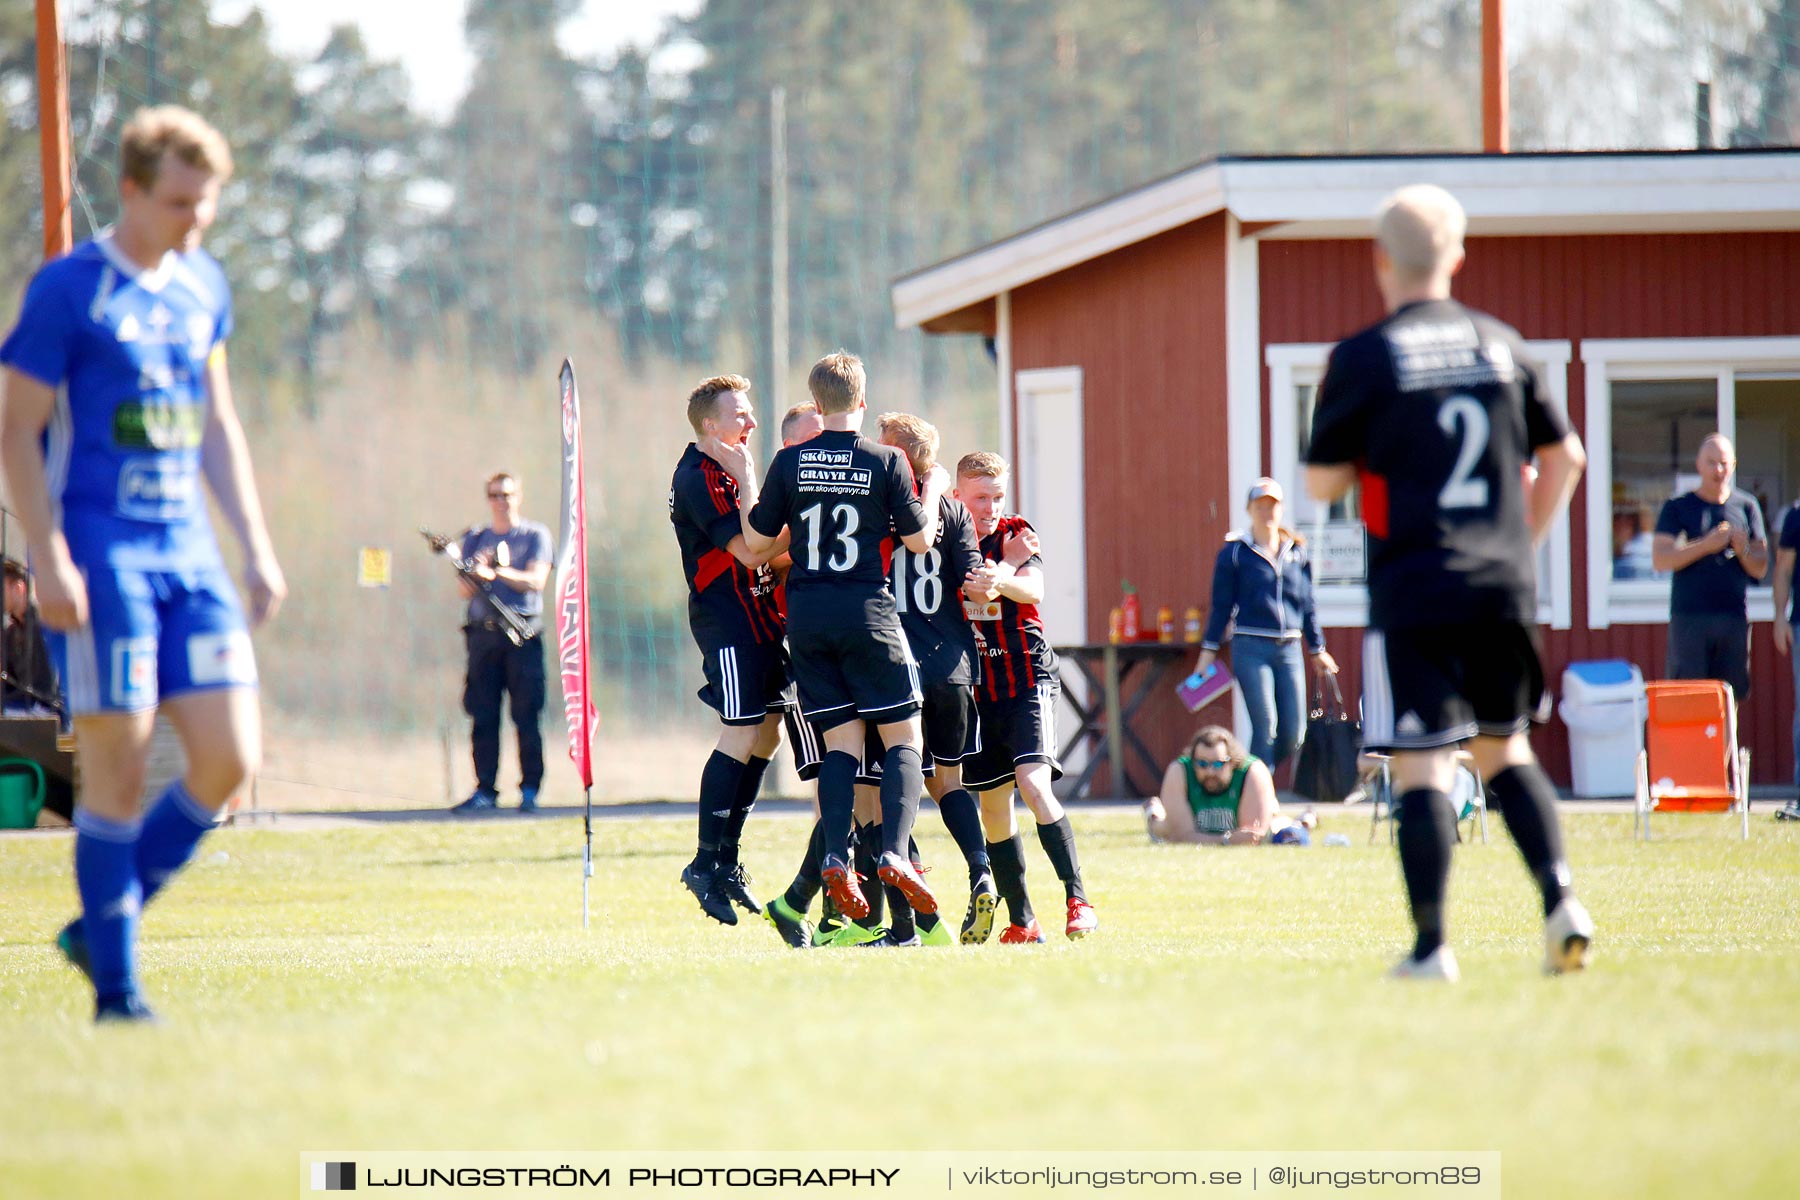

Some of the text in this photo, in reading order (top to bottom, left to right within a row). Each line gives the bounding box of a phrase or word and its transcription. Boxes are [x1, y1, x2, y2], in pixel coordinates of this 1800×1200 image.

[800, 451, 849, 463] SKÖVDE
[1437, 395, 1490, 509] 2
[798, 485, 870, 496] www.skovdegravyr.se
[800, 469, 868, 482] GRAVYR AB
[799, 502, 860, 572] 13
[891, 544, 943, 615] 18
